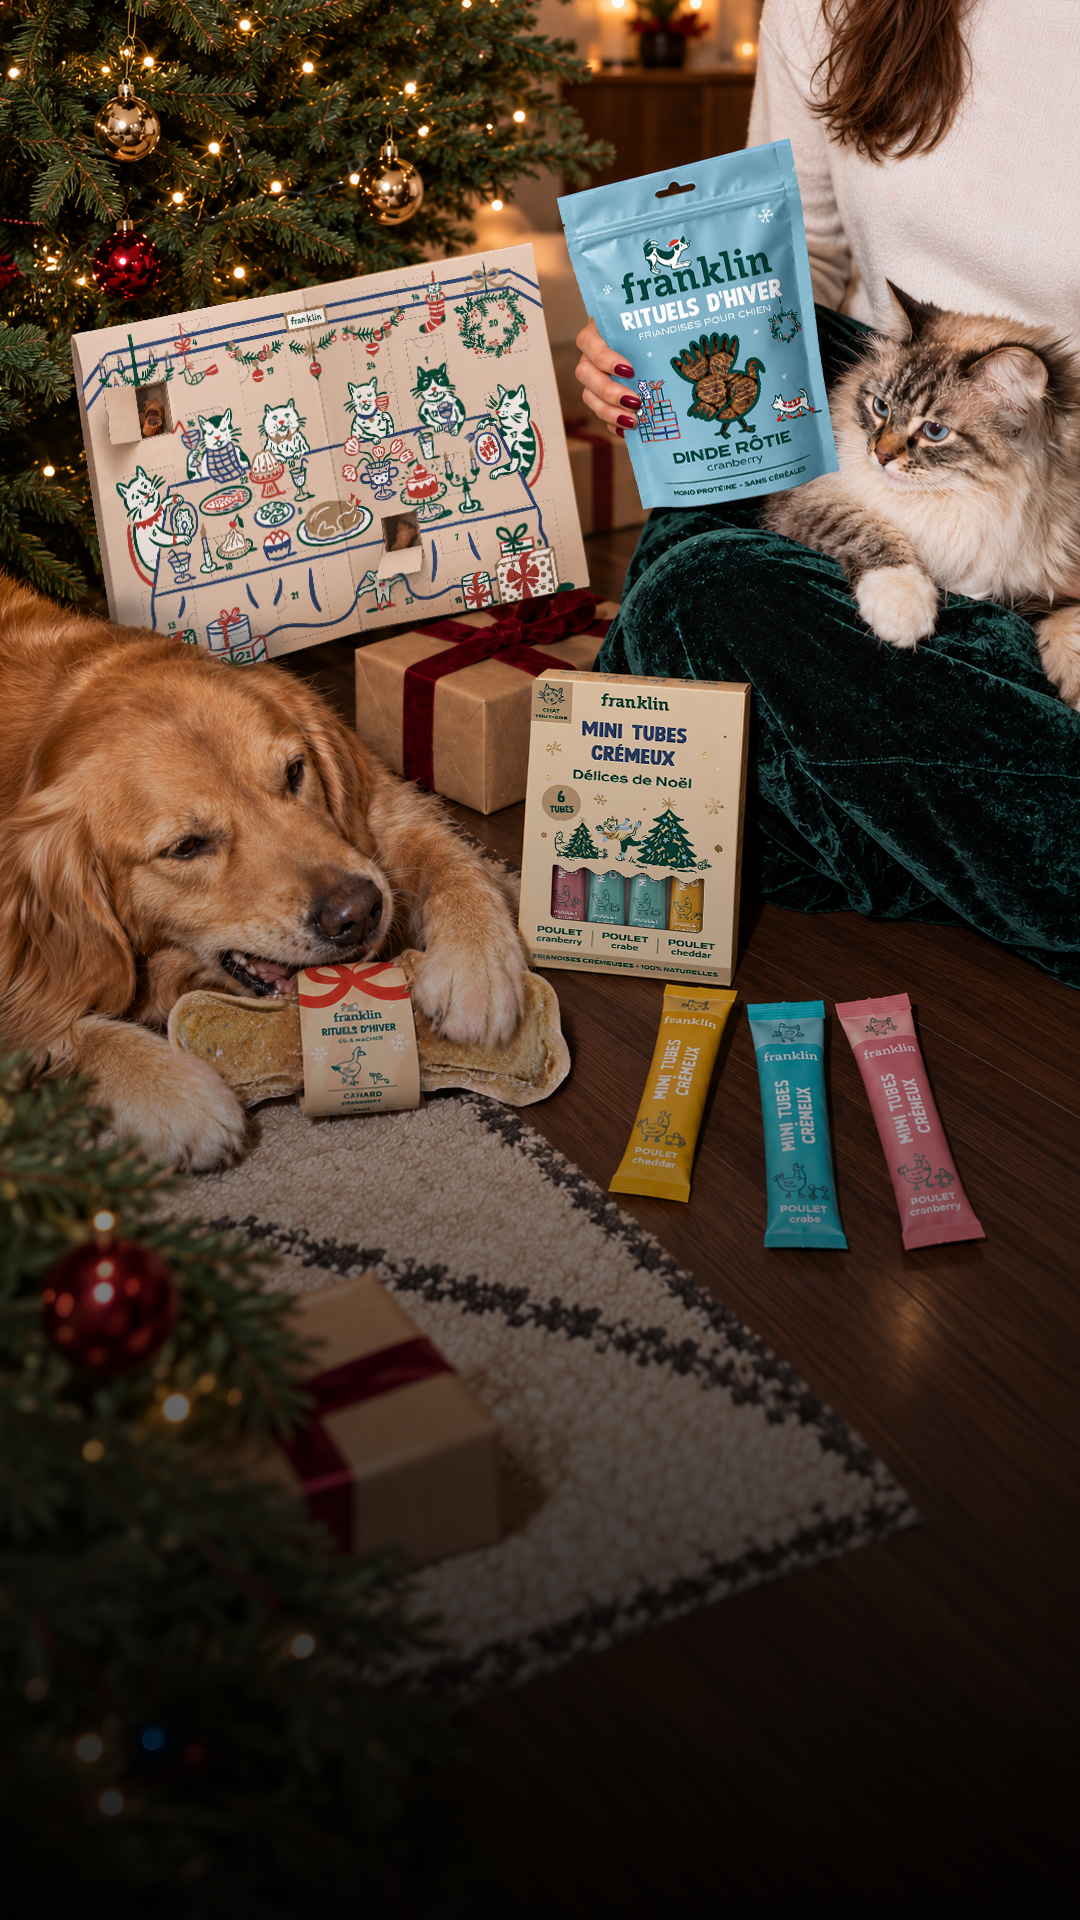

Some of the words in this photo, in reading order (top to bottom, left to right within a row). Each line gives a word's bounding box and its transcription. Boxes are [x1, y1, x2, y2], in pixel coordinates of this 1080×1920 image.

[621, 249, 773, 305] franklin
[411, 293, 420, 301] 14
[620, 297, 700, 331] RITUELS
[707, 278, 783, 314] D'HIVER
[290, 313, 322, 325] franklin
[489, 319, 499, 328] 20
[638, 320, 702, 341] FRIANDISES
[704, 312, 736, 327] POUR
[738, 304, 772, 319] CHIEN
[192, 338, 198, 346] 4
[366, 361, 376, 370] 24
[424, 356, 429, 364] 1
[267, 367, 274, 375] 19
[431, 409, 439, 417] 12
[187, 419, 195, 427] 16
[510, 431, 518, 439] 17
[672, 444, 731, 465] DINDE
[735, 430, 792, 455] RÔTIE
[287, 460, 295, 468] 10
[707, 454, 763, 473] cranberry
[240, 476, 249, 485] 22
[673, 488, 696, 497] MONO
[696, 483, 738, 495] PROTÉINE
[744, 477, 768, 487] SANS
[768, 465, 807, 482] CÉRÉALES
[297, 507, 303, 515] 8
[454, 533, 460, 541] 7
[537, 539, 542, 547] 9
[225, 563, 233, 571] 18
[291, 591, 300, 599] 21
[405, 597, 414, 605] 23
[168, 622, 176, 630] 13
[601, 693, 670, 712] franklin
[581, 720, 623, 739] MINI
[632, 724, 688, 744] TUBES
[591, 743, 676, 767] CRÉMEUX
[572, 769, 629, 784] Délices
[632, 773, 652, 786] de
[656, 775, 693, 789] Noël
[557, 790, 566, 803] 6
[549, 805, 575, 814] TUBES
[537, 925, 583, 937] POULET
[601, 931, 649, 944] POULET
[536, 934, 583, 947] cranberry
[610, 941, 639, 952] crabe
[667, 938, 716, 951] POULET
[670, 948, 712, 959] cheddar
[582, 957, 635, 969] CRÉMEUSES
[640, 964, 662, 972] 100%
[663, 966, 719, 979] NATURELLES
[333, 1010, 382, 1023] franklin
[664, 1015, 717, 1030] franklin
[360, 1023, 397, 1034] D'HIVER
[661, 1039, 681, 1070] TUBES
[763, 1050, 819, 1063] franklin
[863, 1043, 917, 1061] franklin
[652, 1074, 672, 1100] MINI
[880, 1072, 904, 1112] TUBES
[774, 1079, 793, 1118] TUBES
[892, 1115, 914, 1145] MINI
[779, 1122, 796, 1152] MINI
[634, 1146, 679, 1159] POULET
[632, 1157, 677, 1169] cheddar
[910, 1192, 956, 1206] POULET
[780, 1204, 828, 1214] POULET
[909, 1202, 961, 1217] cranberry
[789, 1214, 822, 1224] crabe
